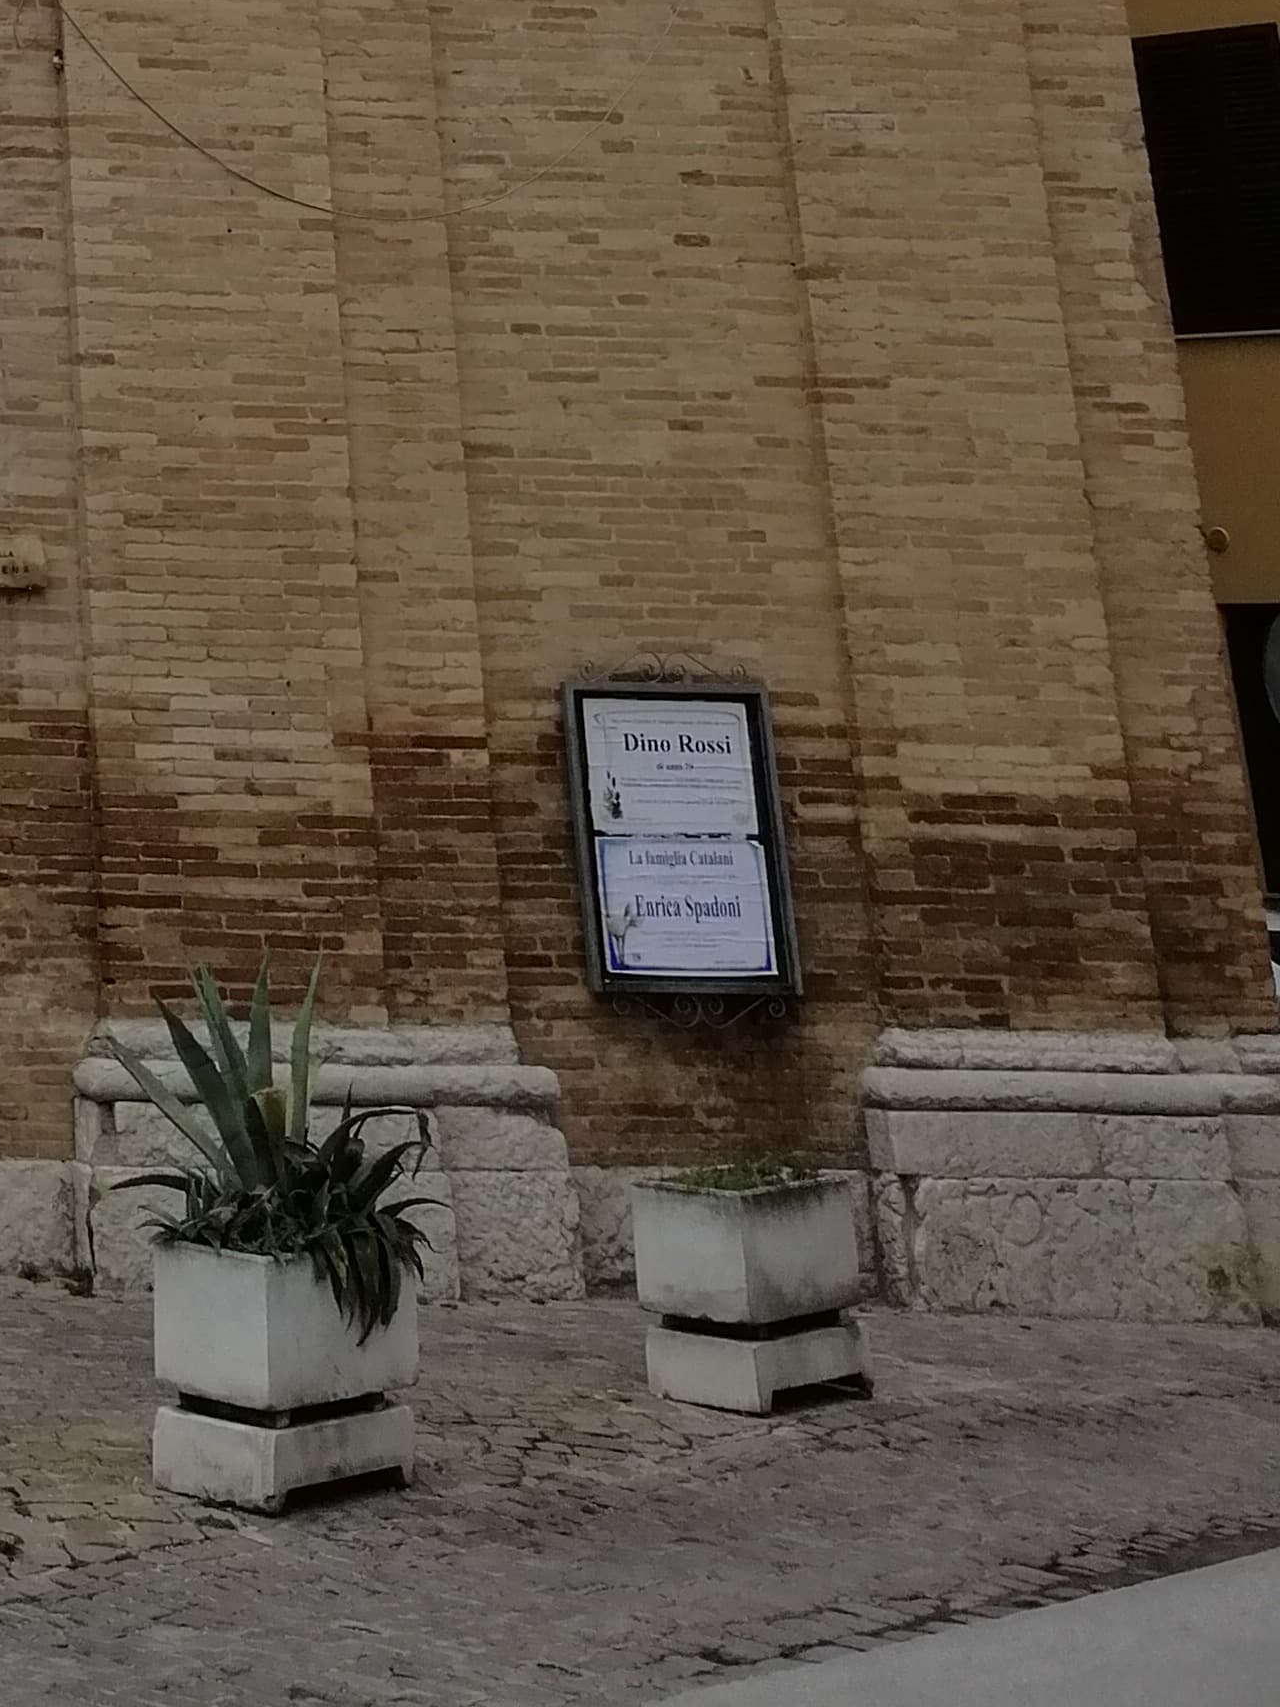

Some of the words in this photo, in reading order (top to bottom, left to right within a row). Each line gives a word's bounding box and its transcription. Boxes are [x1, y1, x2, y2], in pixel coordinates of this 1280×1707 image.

[623, 732, 671, 753] Dino
[677, 734, 732, 755] Rossi
[628, 850, 643, 866] La
[645, 850, 687, 868] famiglia
[689, 850, 734, 866] Catalani
[634, 894, 682, 918] Enrica
[684, 894, 742, 924] Spadoni
